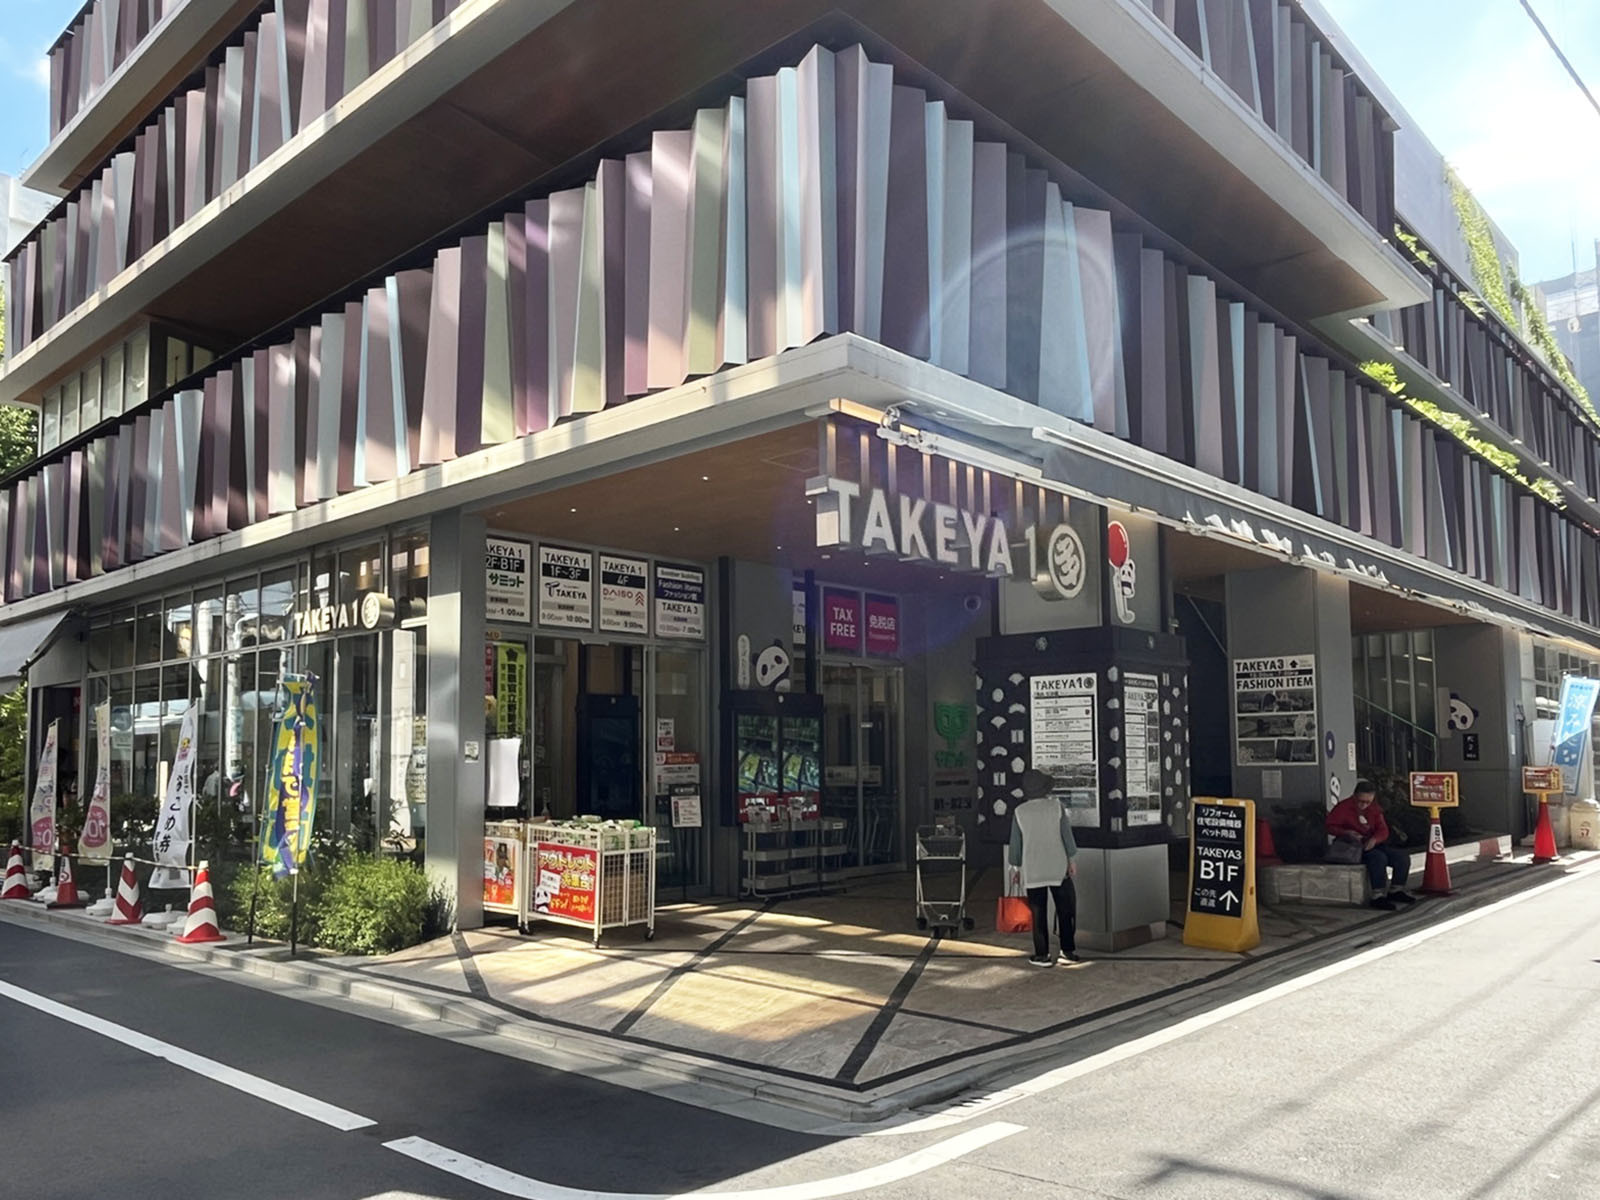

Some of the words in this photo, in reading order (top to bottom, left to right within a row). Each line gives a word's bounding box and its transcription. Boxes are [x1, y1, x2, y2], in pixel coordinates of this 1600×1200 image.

[828, 477, 1014, 576] TAKEYA
[1024, 524, 1037, 583] 1
[545, 552, 580, 567] TAKEYA
[604, 561, 636, 574] TAKEYA
[488, 572, 525, 589] サミット
[617, 576, 630, 585] 4F
[556, 589, 588, 601] TAKEYA
[662, 602, 692, 614] TAKEYA
[832, 606, 854, 621] TAX
[294, 602, 349, 637] TAKEYA
[829, 622, 857, 638] FREE
[1236, 678, 1284, 690] FASHION
[1286, 676, 1314, 688] ITEM
[1201, 807, 1238, 818] リフォーム
[1196, 817, 1243, 829] 住宅設備機器
[1201, 829, 1238, 839] ペット用品
[1197, 846, 1243, 860] TAKEYA3
[539, 849, 597, 873] アウトレット
[1200, 859, 1240, 882] B1F
